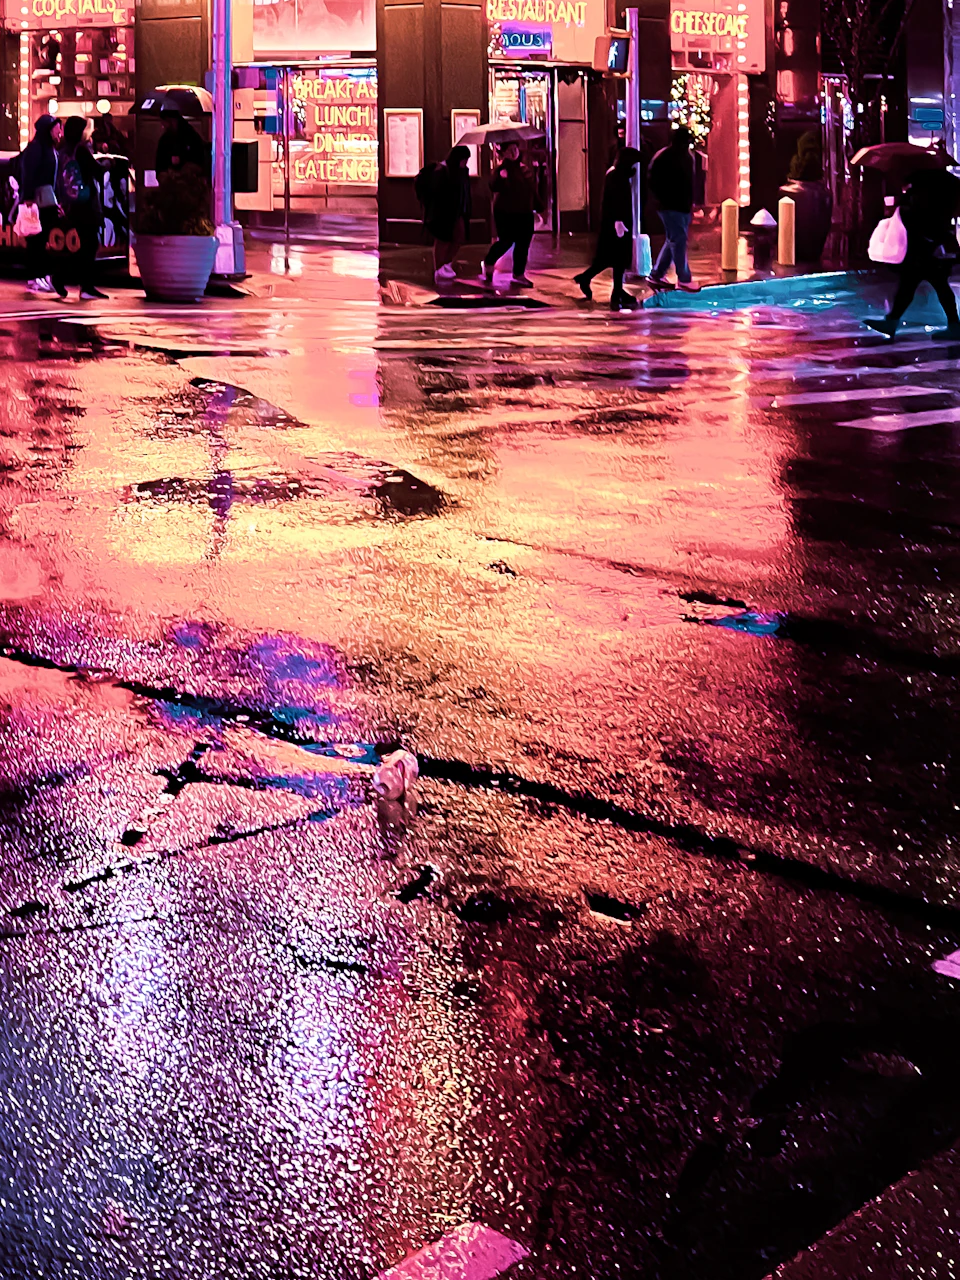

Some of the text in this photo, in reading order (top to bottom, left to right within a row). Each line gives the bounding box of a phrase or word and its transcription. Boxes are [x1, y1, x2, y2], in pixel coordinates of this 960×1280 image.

[670, 10, 749, 37] CHEESECAKE
[294, 78, 378, 99] BREAKFAS
[314, 106, 370, 127] LUNCH
[313, 133, 373, 153] DINNER
[294, 159, 378, 182] LATE-NIG
